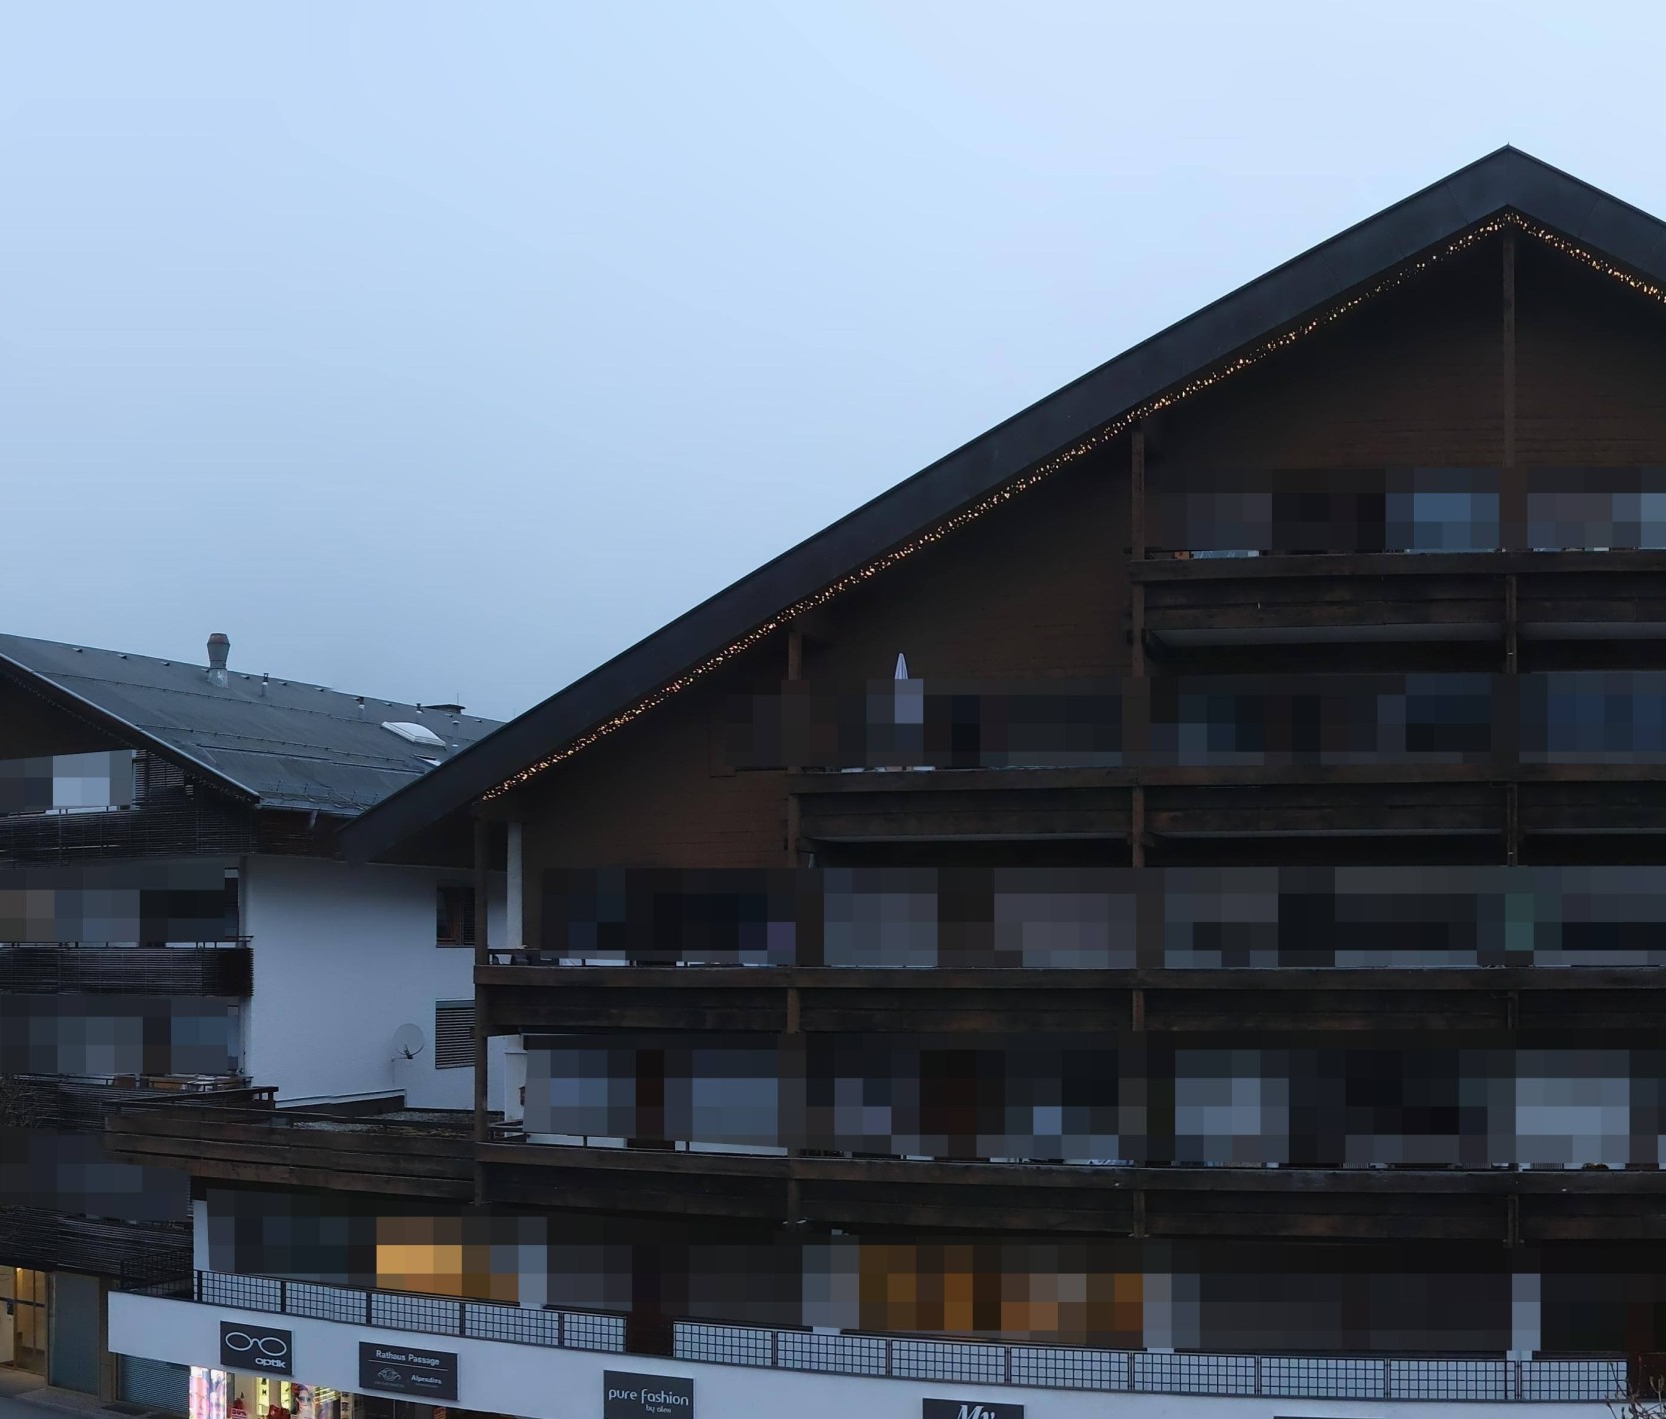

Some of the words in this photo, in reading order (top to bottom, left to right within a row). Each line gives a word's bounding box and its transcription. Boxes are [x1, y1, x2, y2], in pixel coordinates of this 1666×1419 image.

[255, 1357, 286, 1369] optik
[376, 1350, 406, 1361] Rathaus
[408, 1354, 440, 1366] Passage
[608, 1389, 637, 1401] pure
[641, 1388, 689, 1406] fashion
[645, 1404, 655, 1413] by
